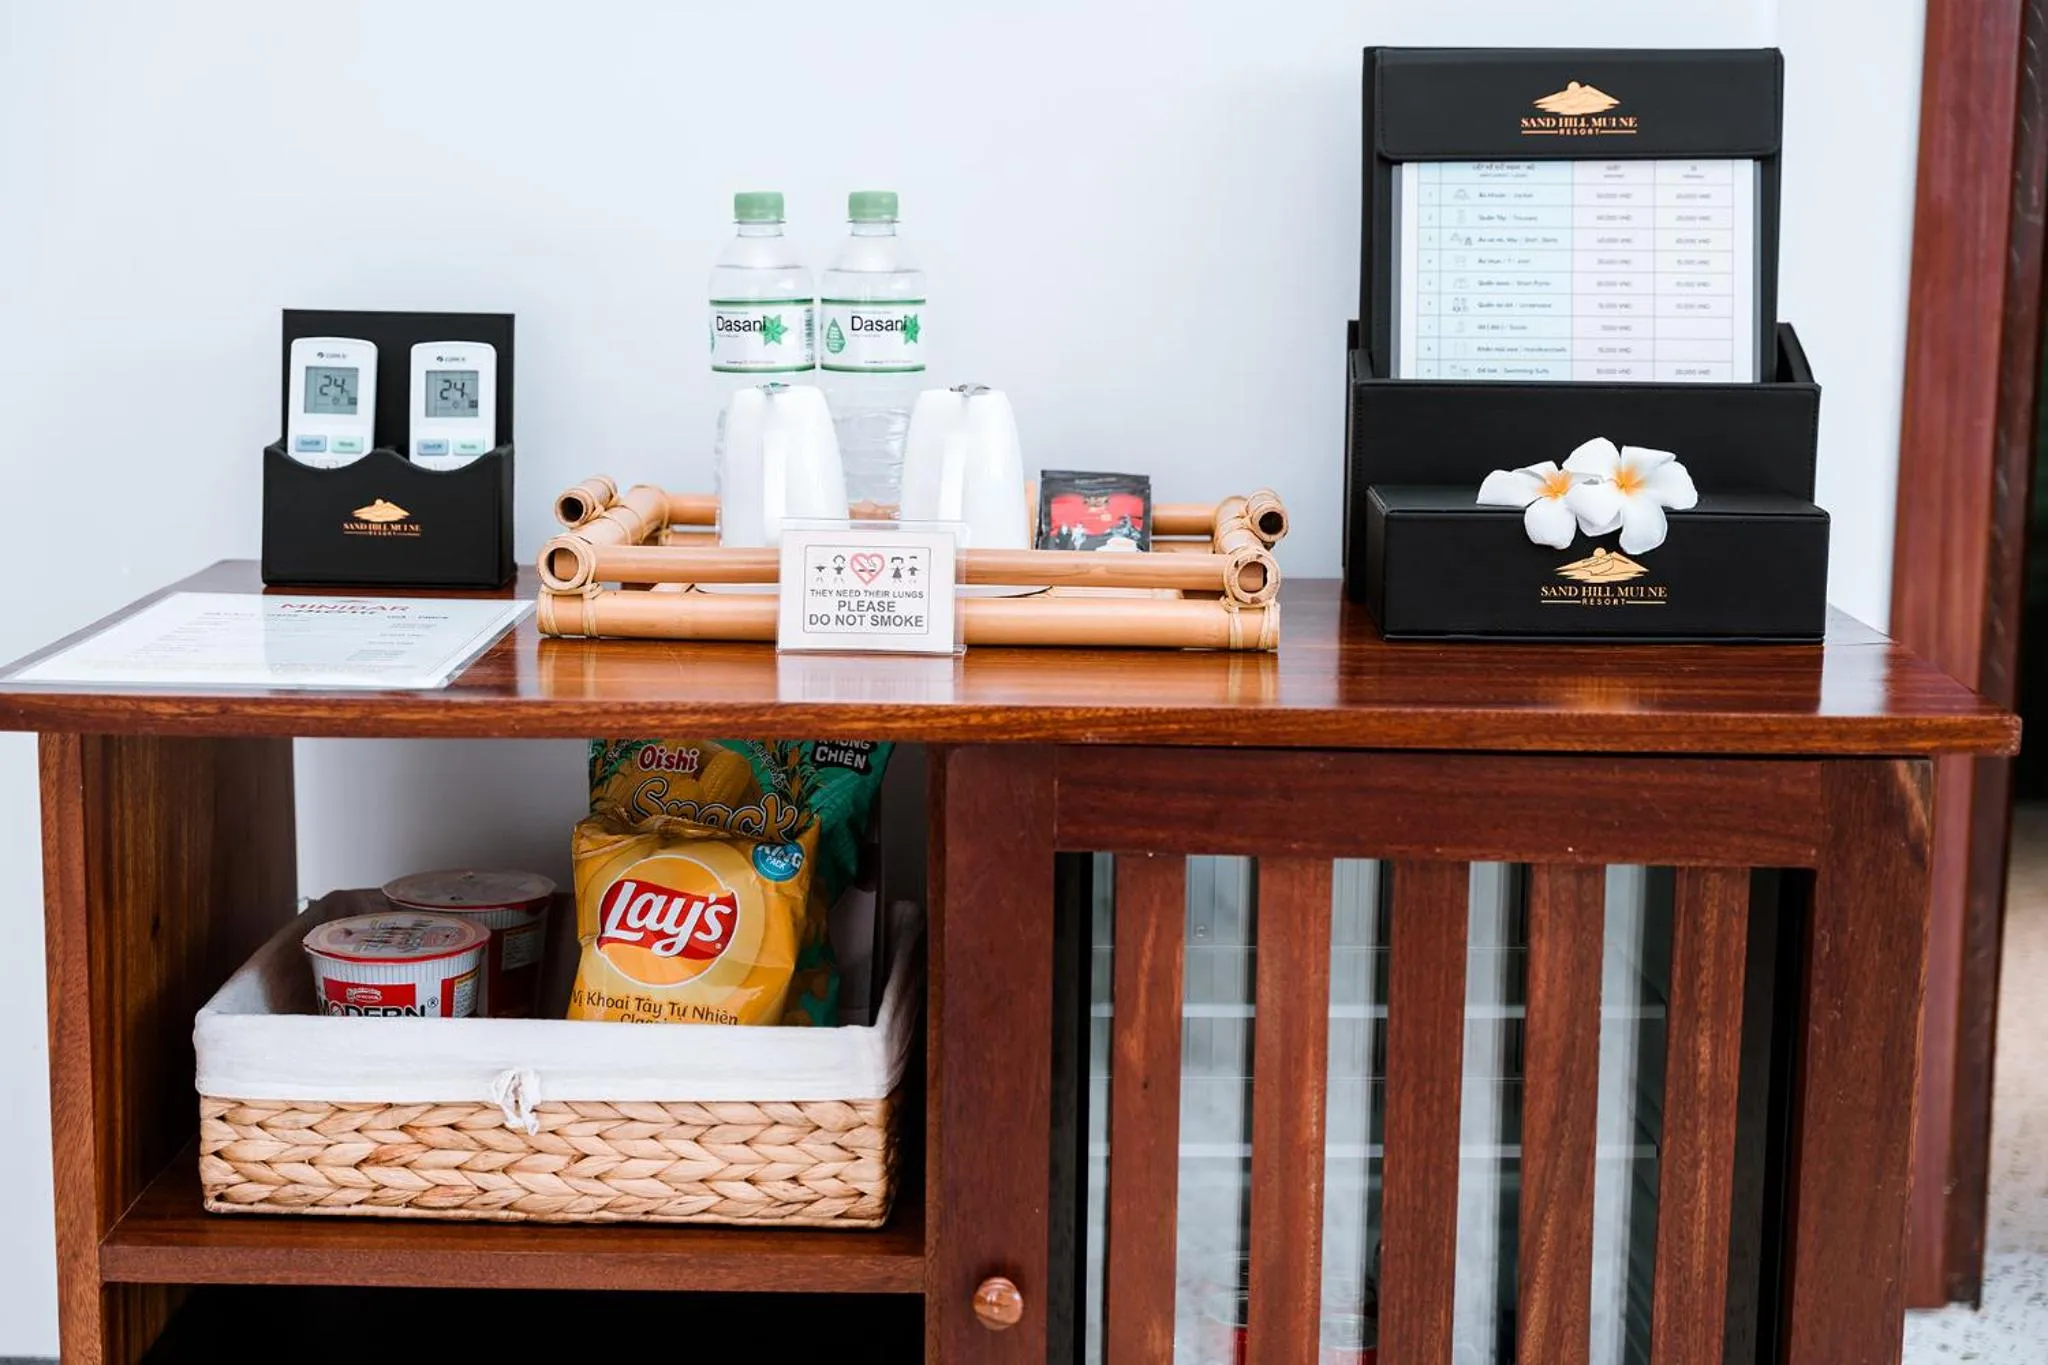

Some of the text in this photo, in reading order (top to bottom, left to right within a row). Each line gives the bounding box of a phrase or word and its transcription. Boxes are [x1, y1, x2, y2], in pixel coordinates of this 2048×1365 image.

[1520, 117, 1556, 127] SAND
[1558, 117, 1589, 127] HILL
[716, 315, 766, 332] Dasani
[851, 315, 907, 332] Dasani
[319, 374, 346, 396] 24
[439, 379, 465, 400] 24
[810, 589, 924, 599] THEY NEED THEIR LUNGS
[1540, 586, 1579, 597] SAND
[1581, 586, 1614, 597] HILL
[281, 602, 410, 611] MINIBAR
[837, 600, 896, 613] PLEASE
[809, 614, 924, 627] DO NOT SMOKE
[638, 744, 700, 773] Oishi
[815, 746, 867, 769] CHIÊN
[632, 777, 798, 841] Snack
[601, 881, 732, 957] Lay's
[587, 991, 630, 1011] Khoai
[635, 996, 662, 1019] Tây
[668, 1001, 688, 1022] Tự
[692, 1005, 738, 1025] Nhiên
